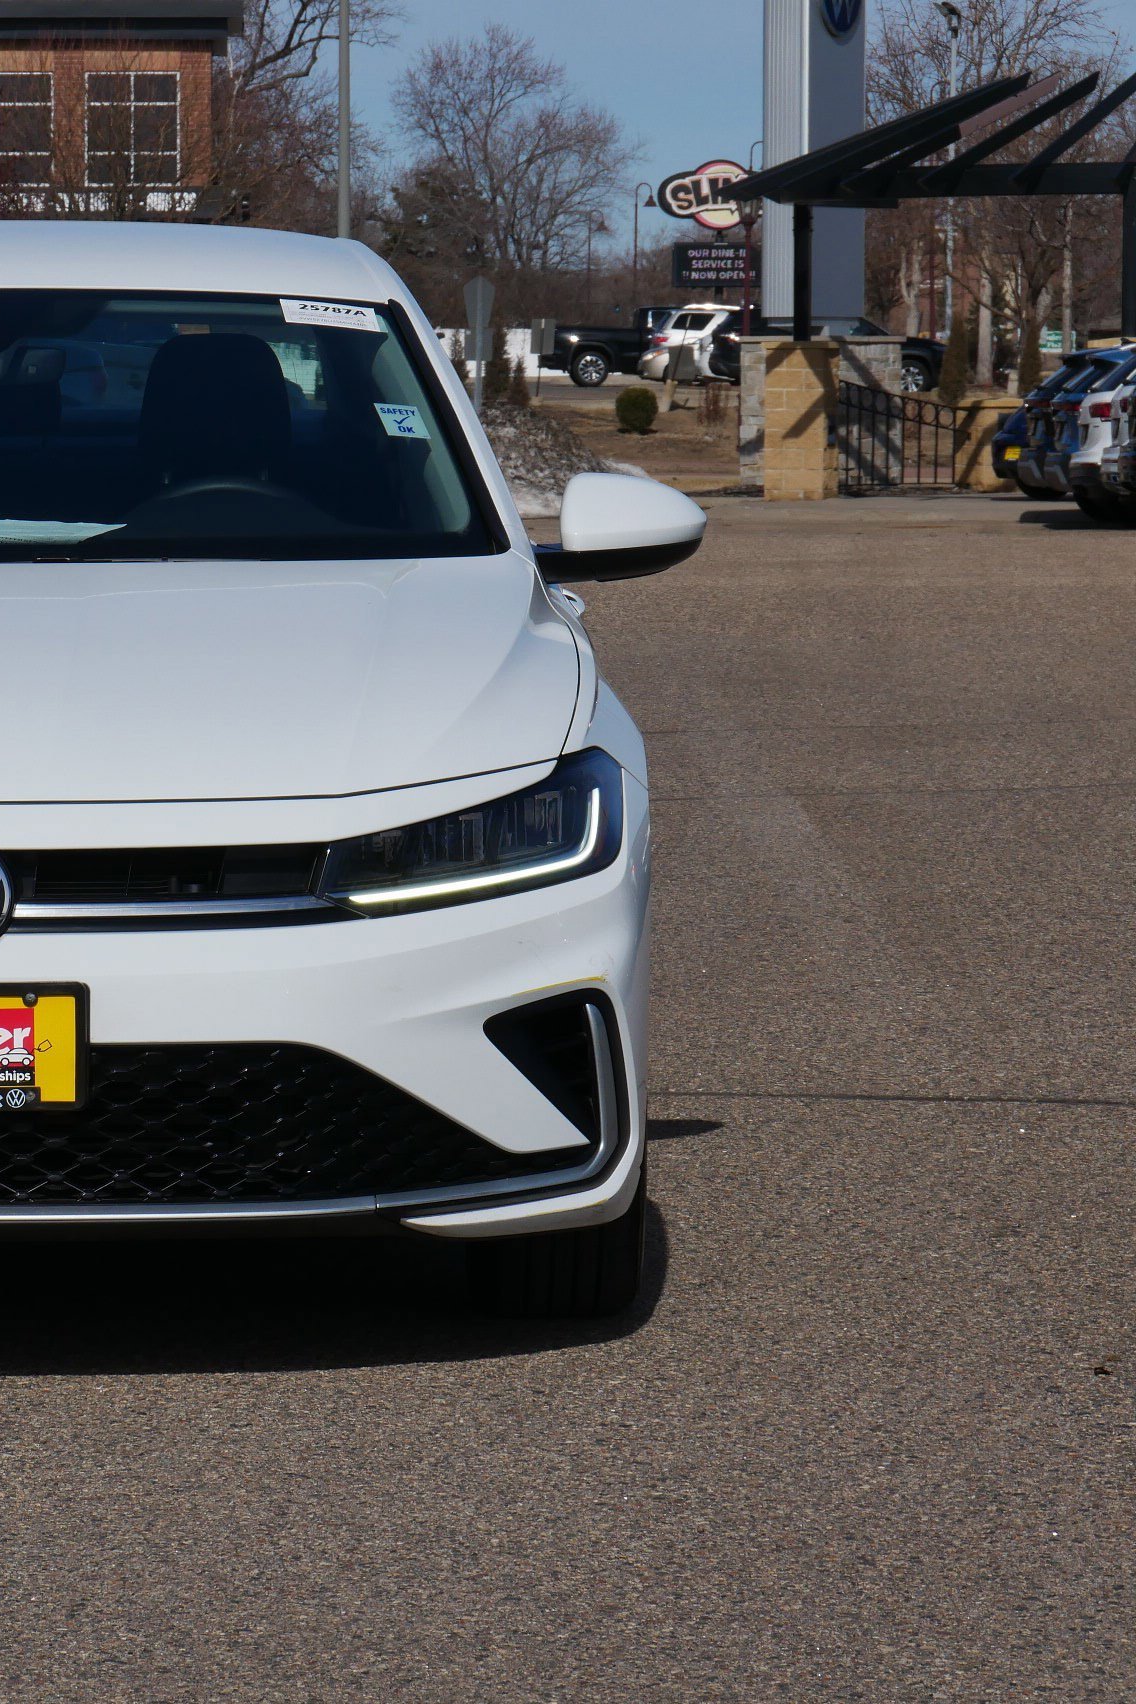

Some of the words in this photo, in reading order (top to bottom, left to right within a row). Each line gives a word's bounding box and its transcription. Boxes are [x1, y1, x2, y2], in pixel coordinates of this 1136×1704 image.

[687, 249, 709, 258] OUR
[691, 260, 732, 269] SERVICE
[734, 260, 745, 269] IS
[690, 270, 717, 280] NOW
[298, 303, 367, 317] 25787A
[379, 407, 416, 417] SAFETY
[397, 425, 415, 434] OK
